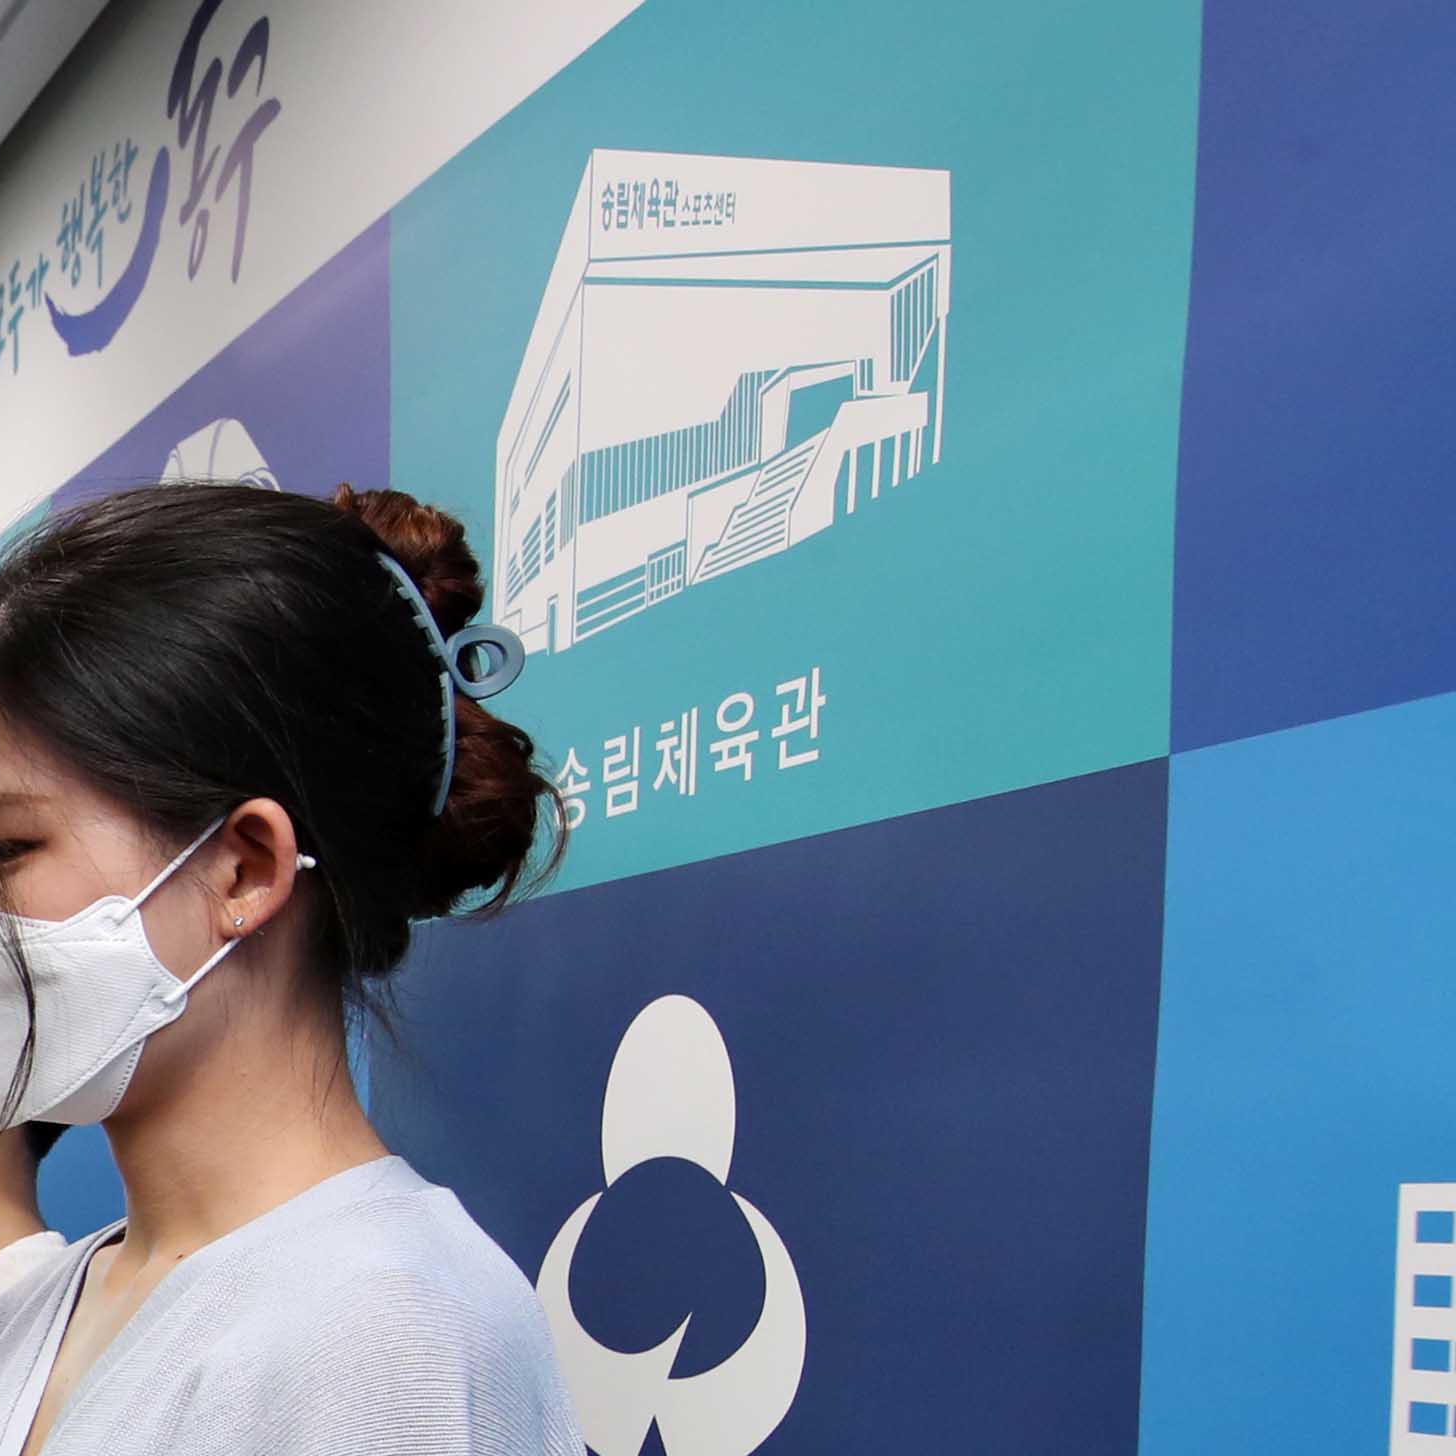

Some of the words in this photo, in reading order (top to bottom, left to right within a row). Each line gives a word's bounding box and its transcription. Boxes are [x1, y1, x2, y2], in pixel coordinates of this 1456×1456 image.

[56, 138, 138, 289] 행복한
[601, 178, 679, 231] 송림체육관
[680, 191, 736, 225] 스포츠센터
[555, 666, 826, 830] 송림체육관
